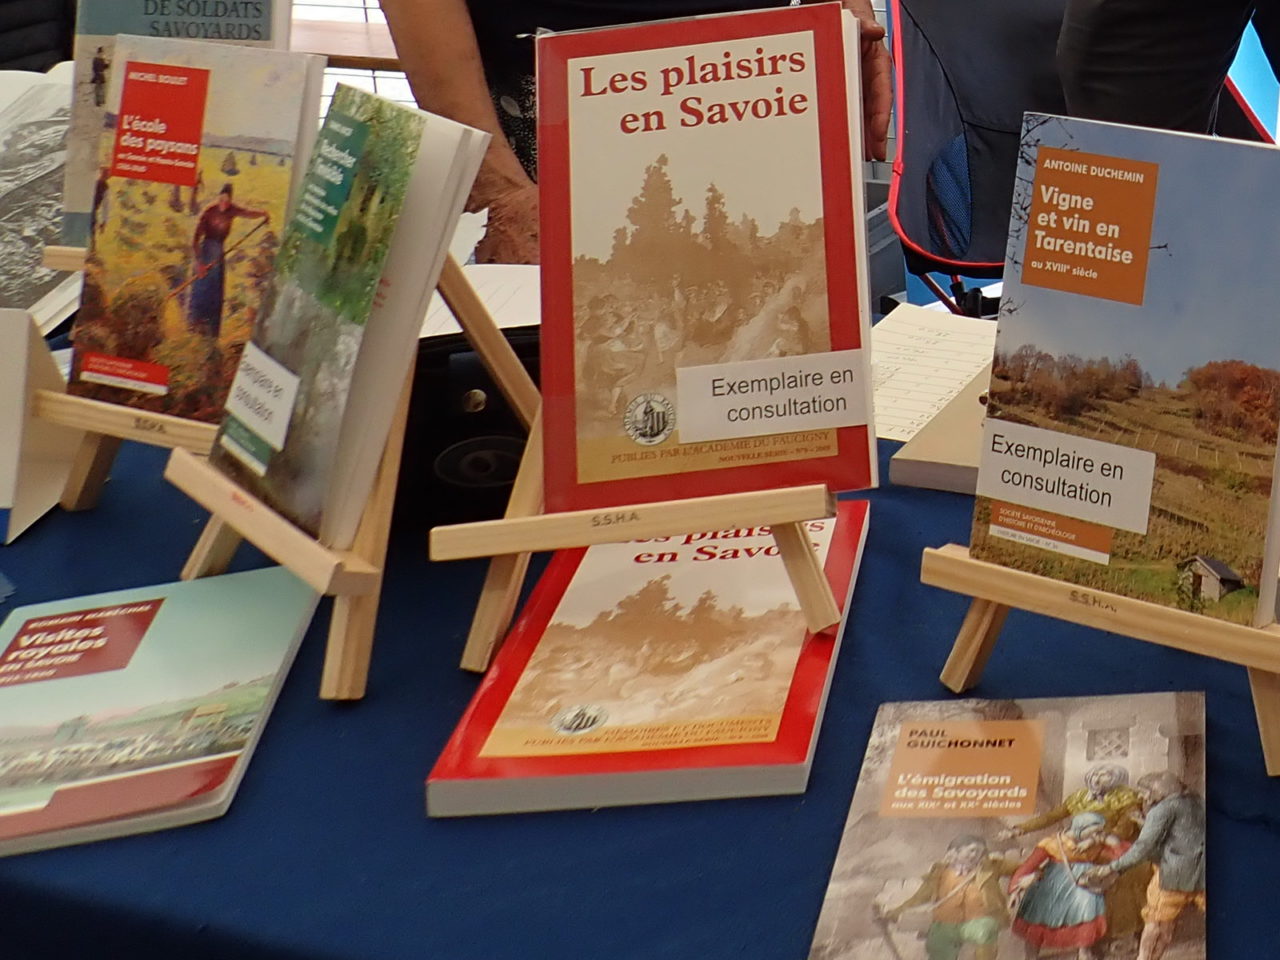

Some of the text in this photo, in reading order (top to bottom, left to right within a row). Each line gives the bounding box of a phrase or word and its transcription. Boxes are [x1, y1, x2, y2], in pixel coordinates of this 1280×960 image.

[175, 1, 263, 20] SOLDATS
[149, 21, 263, 40] SAVOYARDS
[580, 47, 806, 97] Les plaisirs
[619, 86, 809, 134] en Savoie
[122, 115, 167, 134] L'école
[120, 133, 199, 155] des paysans
[1043, 159, 1144, 184] ANTOINE DUCHEMIN
[1041, 184, 1094, 211] Vigne
[1037, 212, 1120, 238] et vin en
[1035, 230, 1134, 265] Tarentaise
[1031, 261, 1043, 269] au
[1072, 265, 1098, 279] siècle
[712, 368, 853, 396] Exemplaire en
[727, 395, 847, 423] consultation
[754, 438, 771, 449] DU
[991, 434, 1124, 480] Exemplaire en
[1001, 468, 1112, 507] consultation
[633, 551, 680, 563] en
[19, 626, 106, 647] Visites
[6, 637, 110, 661] royales
[907, 738, 1016, 749] GUICHONNET
[908, 729, 949, 738] PAUL
[897, 773, 1012, 788] L'émigration
[894, 786, 1028, 800] des Savoyards
[944, 800, 957, 809] et
[982, 800, 1022, 809] siècles
